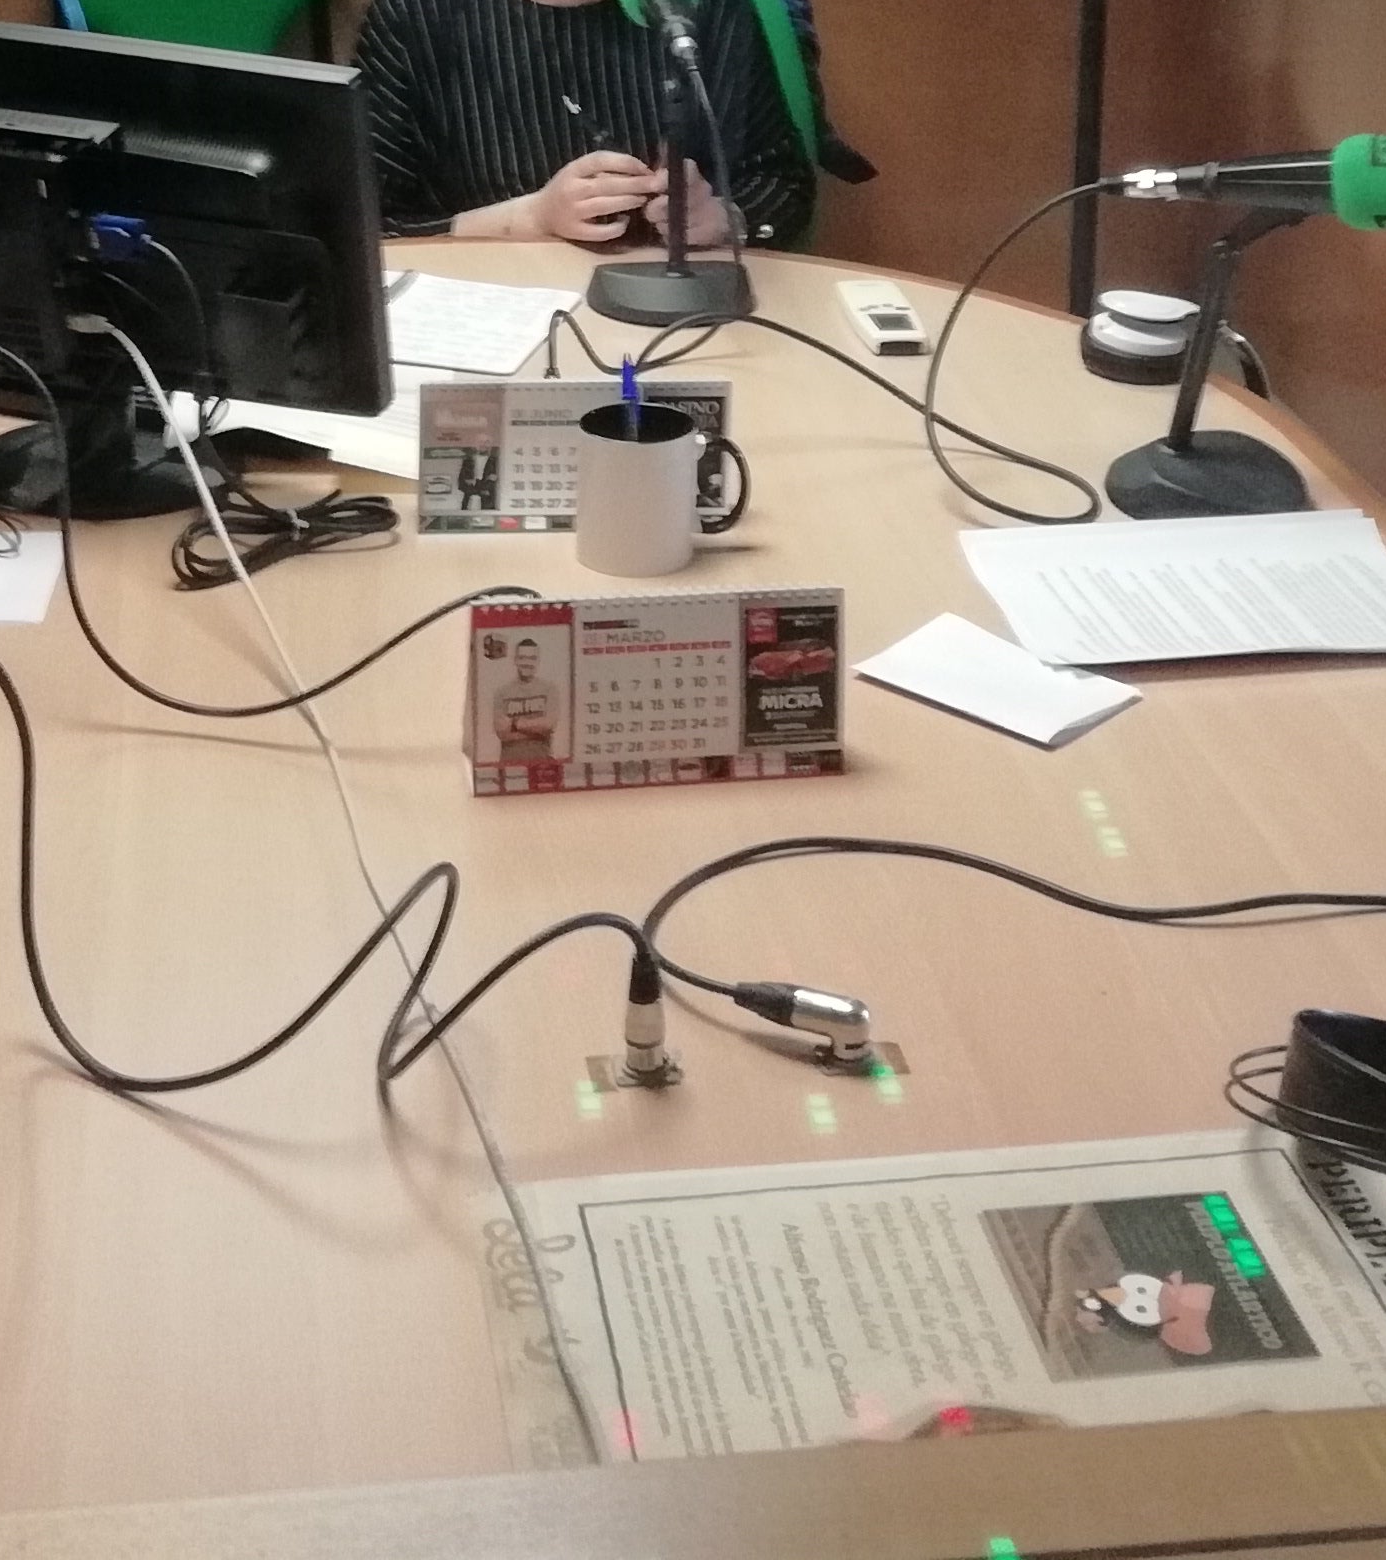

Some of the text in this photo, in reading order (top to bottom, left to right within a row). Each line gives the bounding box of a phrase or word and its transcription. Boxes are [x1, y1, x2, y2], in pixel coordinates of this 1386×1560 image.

[674, 656, 683, 667] 2
[696, 655, 704, 666] 3
[717, 655, 725, 665] 4
[693, 676, 708, 688] 10
[586, 702, 601, 713] 12
[758, 693, 824, 710] MICRA
[586, 723, 601, 734] 19
[605, 722, 624, 733] 20
